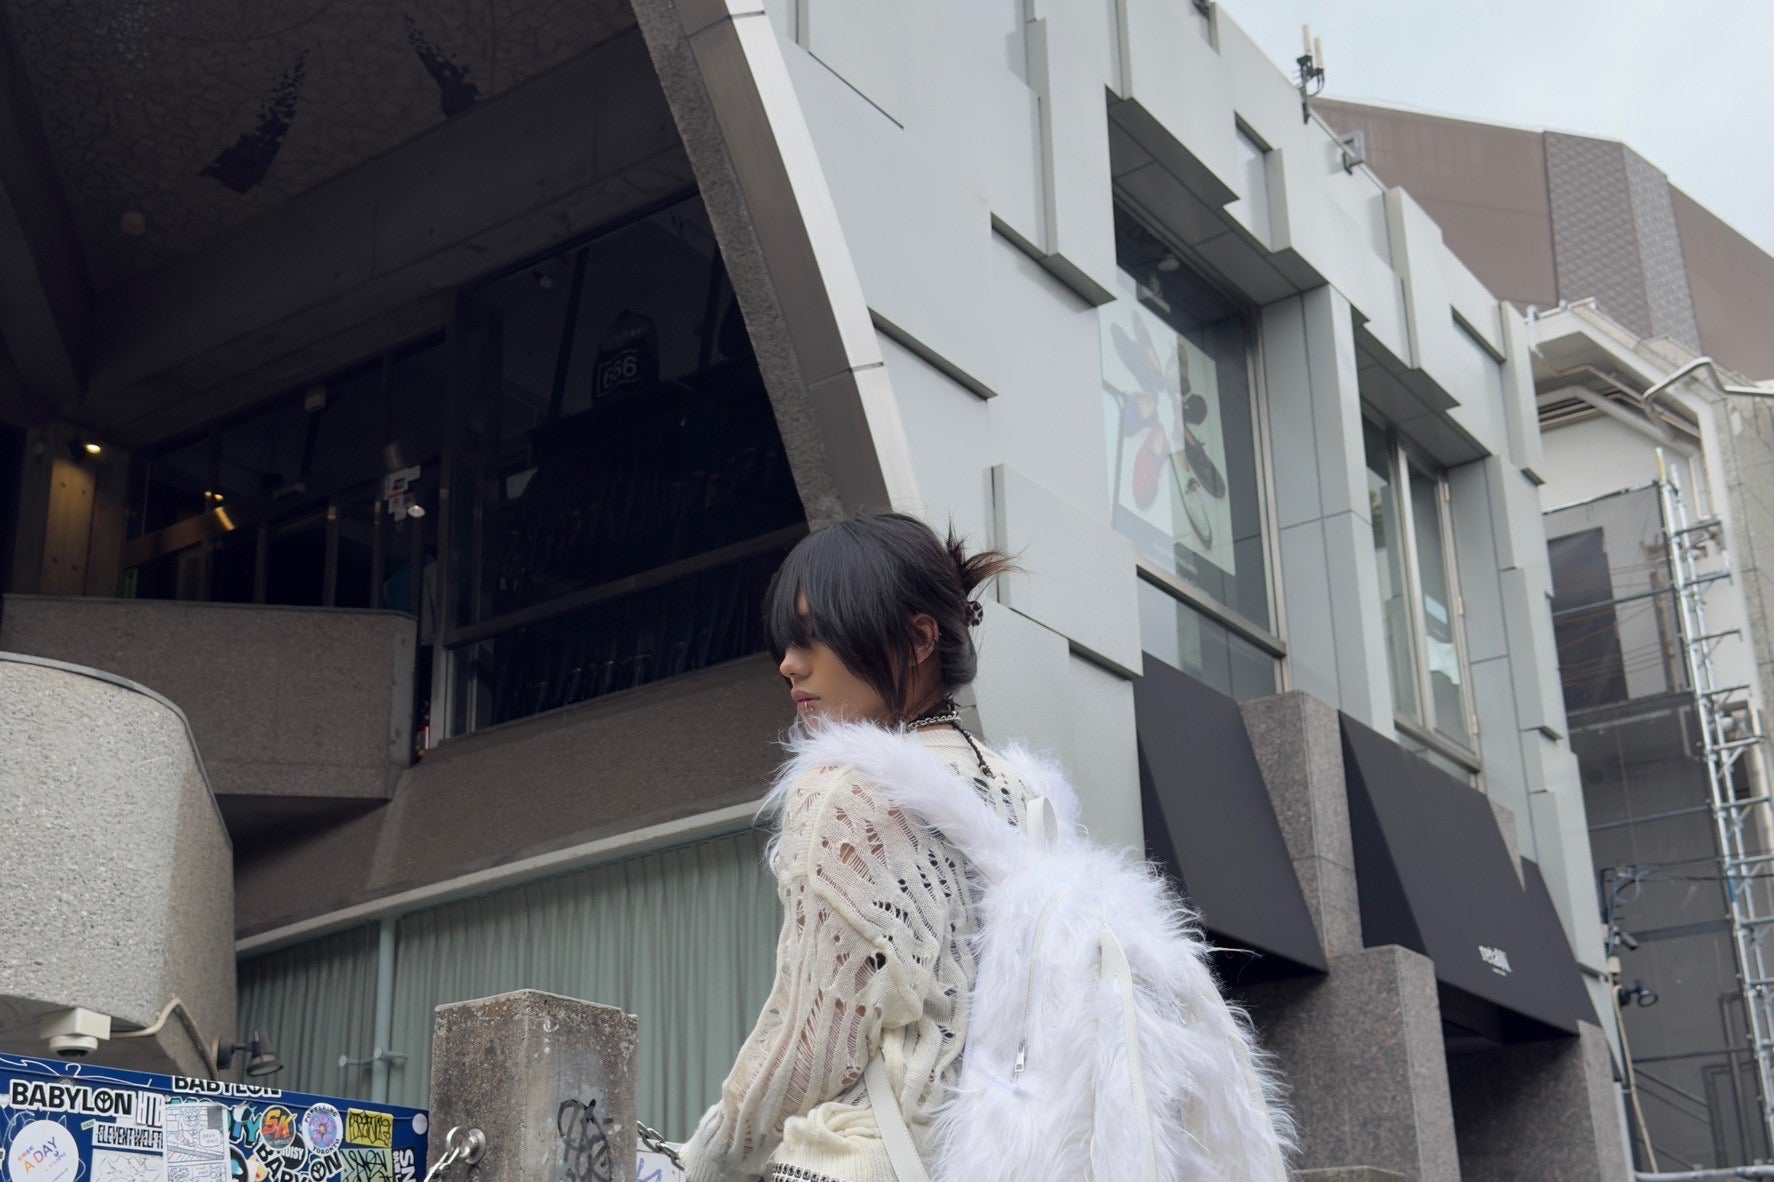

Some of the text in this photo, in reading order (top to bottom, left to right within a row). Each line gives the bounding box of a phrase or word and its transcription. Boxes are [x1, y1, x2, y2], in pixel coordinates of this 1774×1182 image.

[11, 1081, 133, 1116] BABYLON
[32, 1136, 58, 1164] DAY
[312, 1138, 340, 1155] TORONTO
